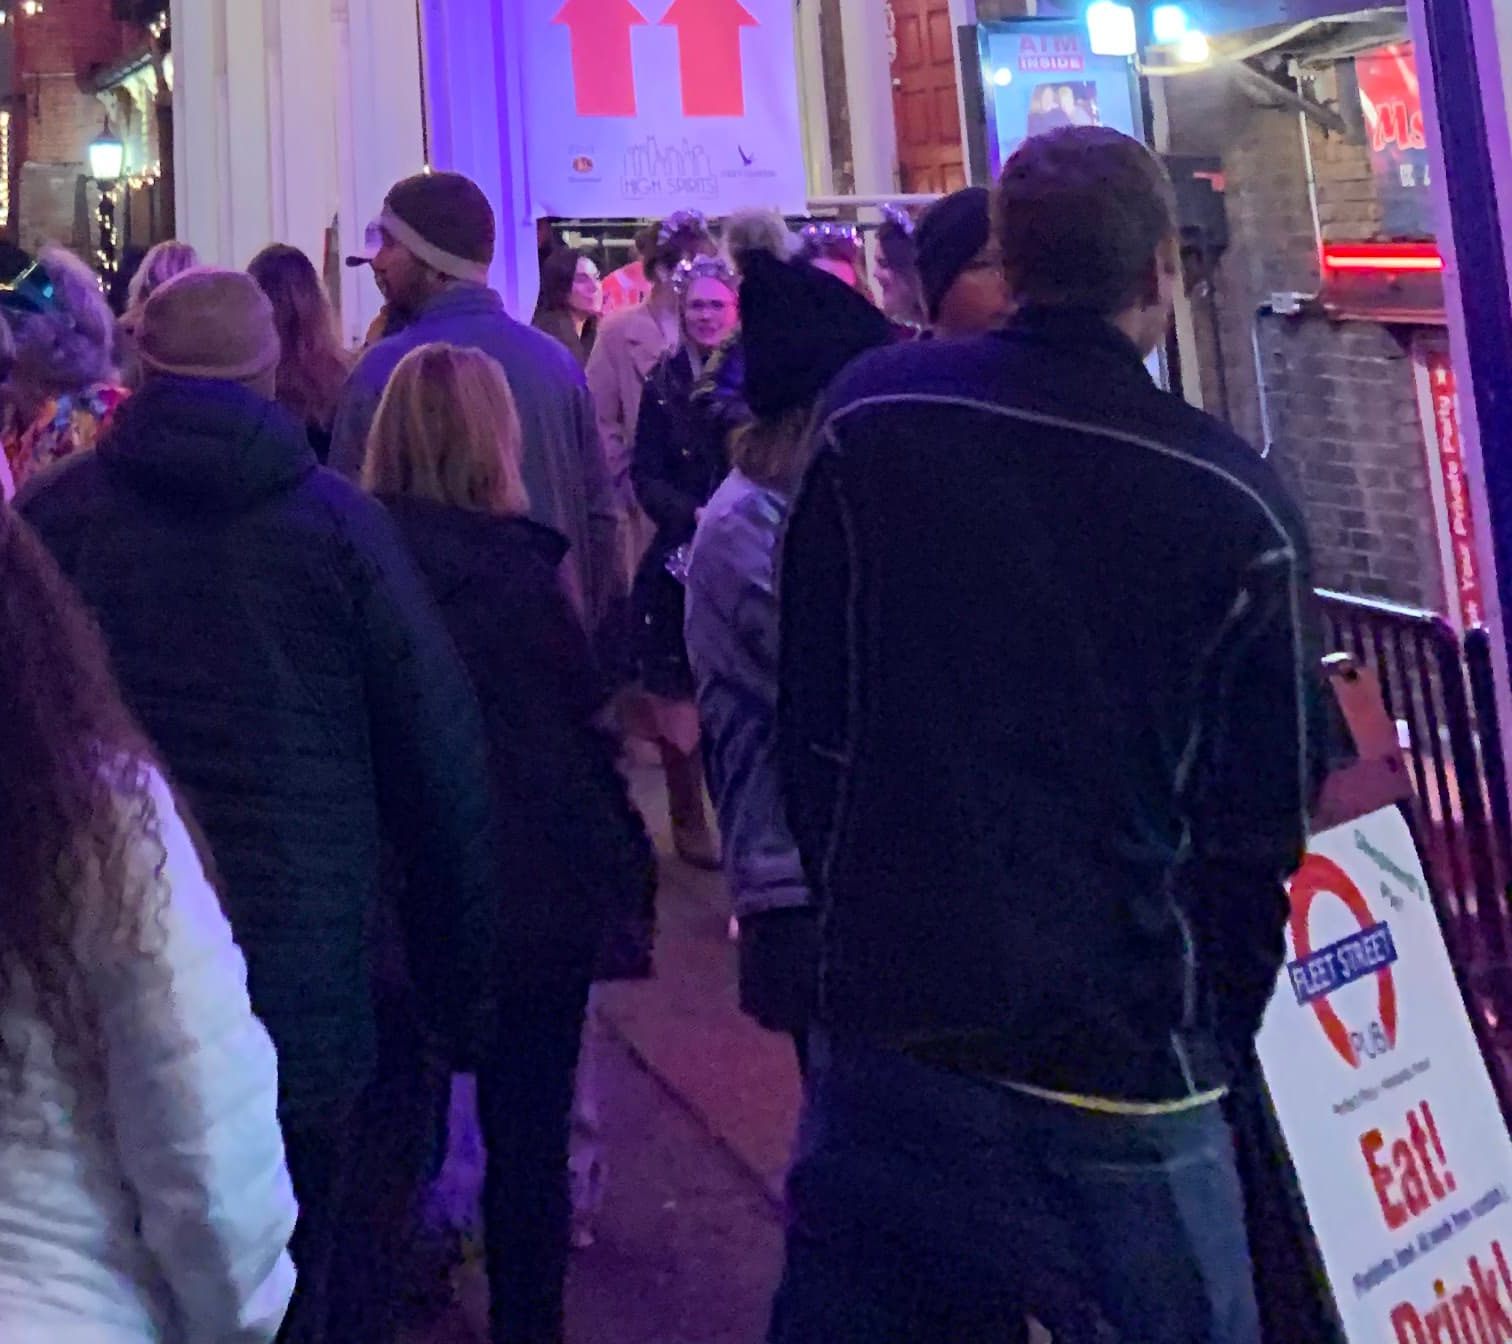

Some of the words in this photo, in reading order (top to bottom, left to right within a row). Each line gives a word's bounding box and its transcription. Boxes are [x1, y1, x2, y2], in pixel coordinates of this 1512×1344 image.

[1019, 33, 1079, 52] ATM
[1019, 56, 1082, 71] INSIDE
[1292, 948, 1339, 1004] FLEET
[1337, 932, 1391, 983] STREET
[1350, 1021, 1388, 1059] PUB
[1360, 1100, 1457, 1230] Eat!
